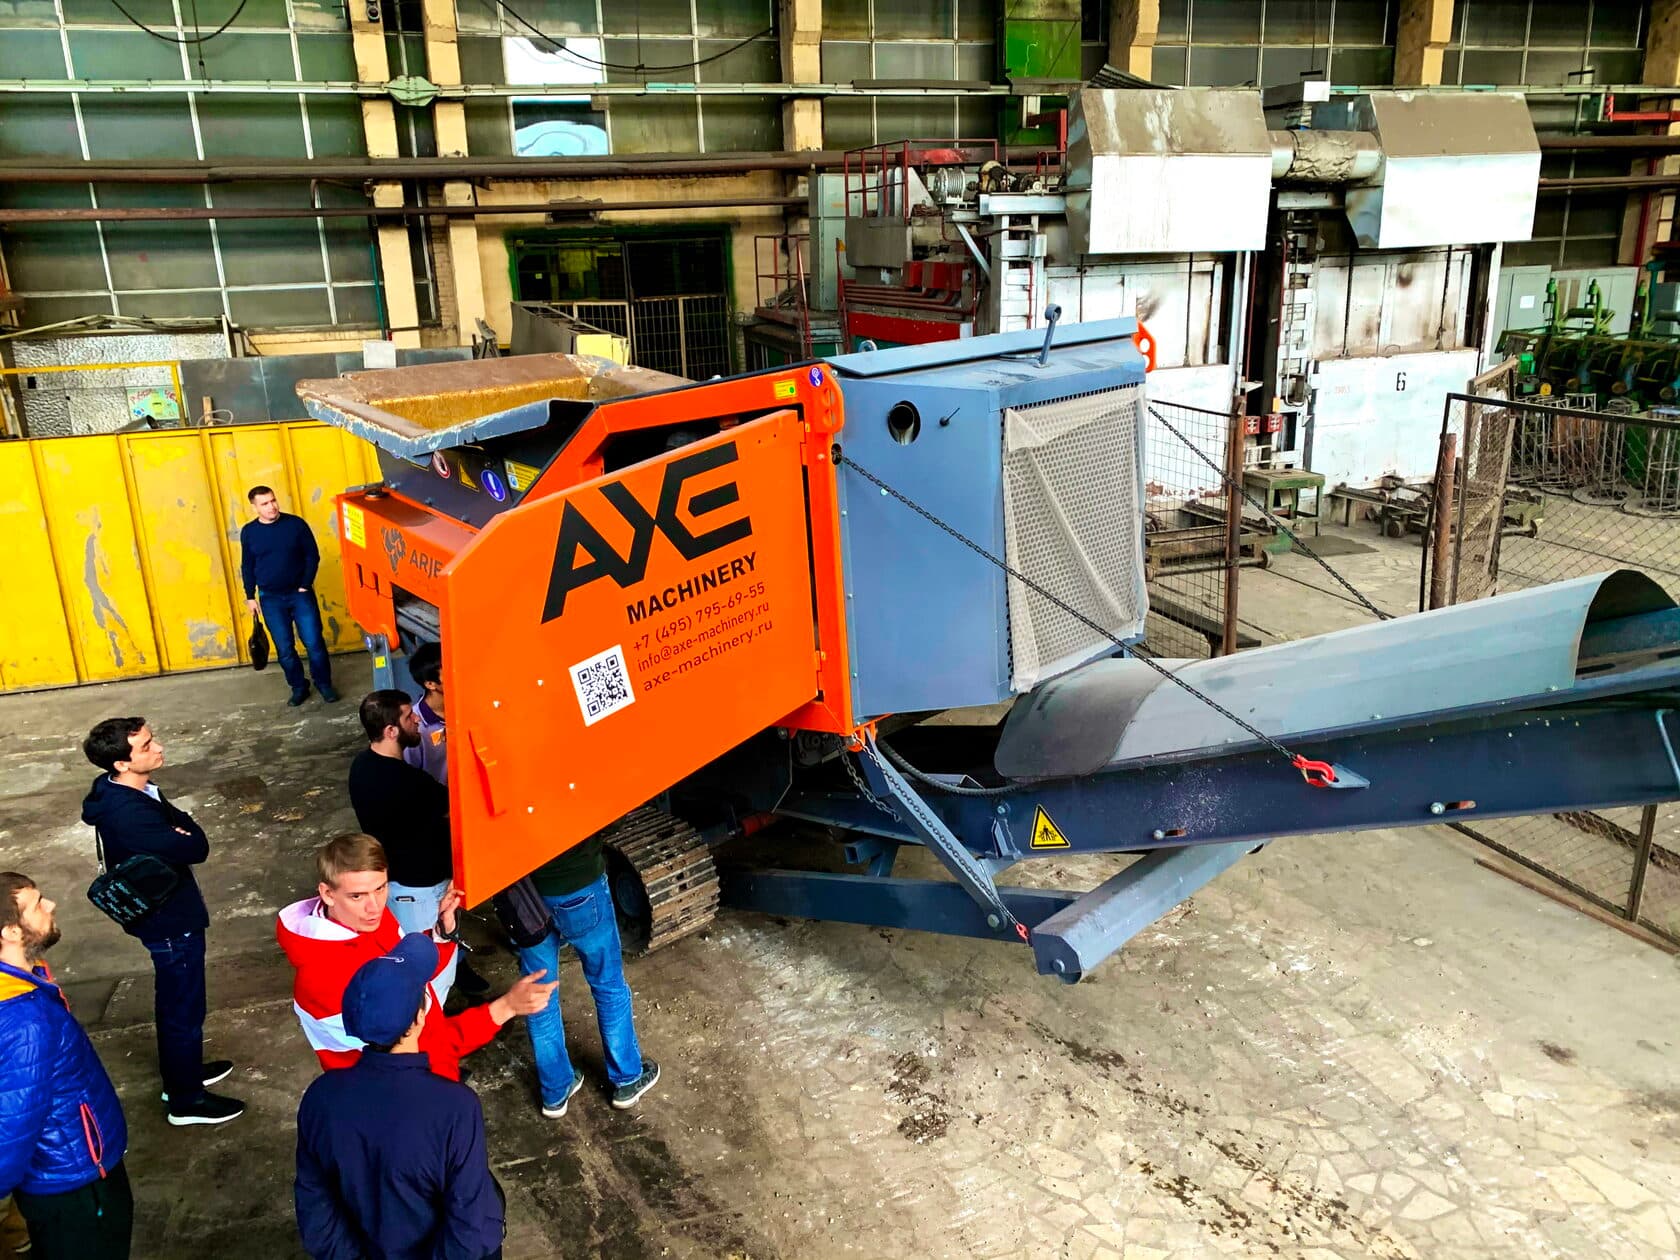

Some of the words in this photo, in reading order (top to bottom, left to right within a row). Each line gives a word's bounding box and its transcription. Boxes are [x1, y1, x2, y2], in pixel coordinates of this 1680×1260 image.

[1396, 372, 1407, 391] 6
[541, 441, 753, 624] AXE
[626, 551, 757, 625] MACHINERY
[633, 634, 649, 652] +7
[656, 615, 693, 644] (495)
[695, 581, 766, 623] 795-69-55
[637, 602, 770, 672] info@axe-machinery.ru
[643, 621, 773, 692] axe-machinery.ru
